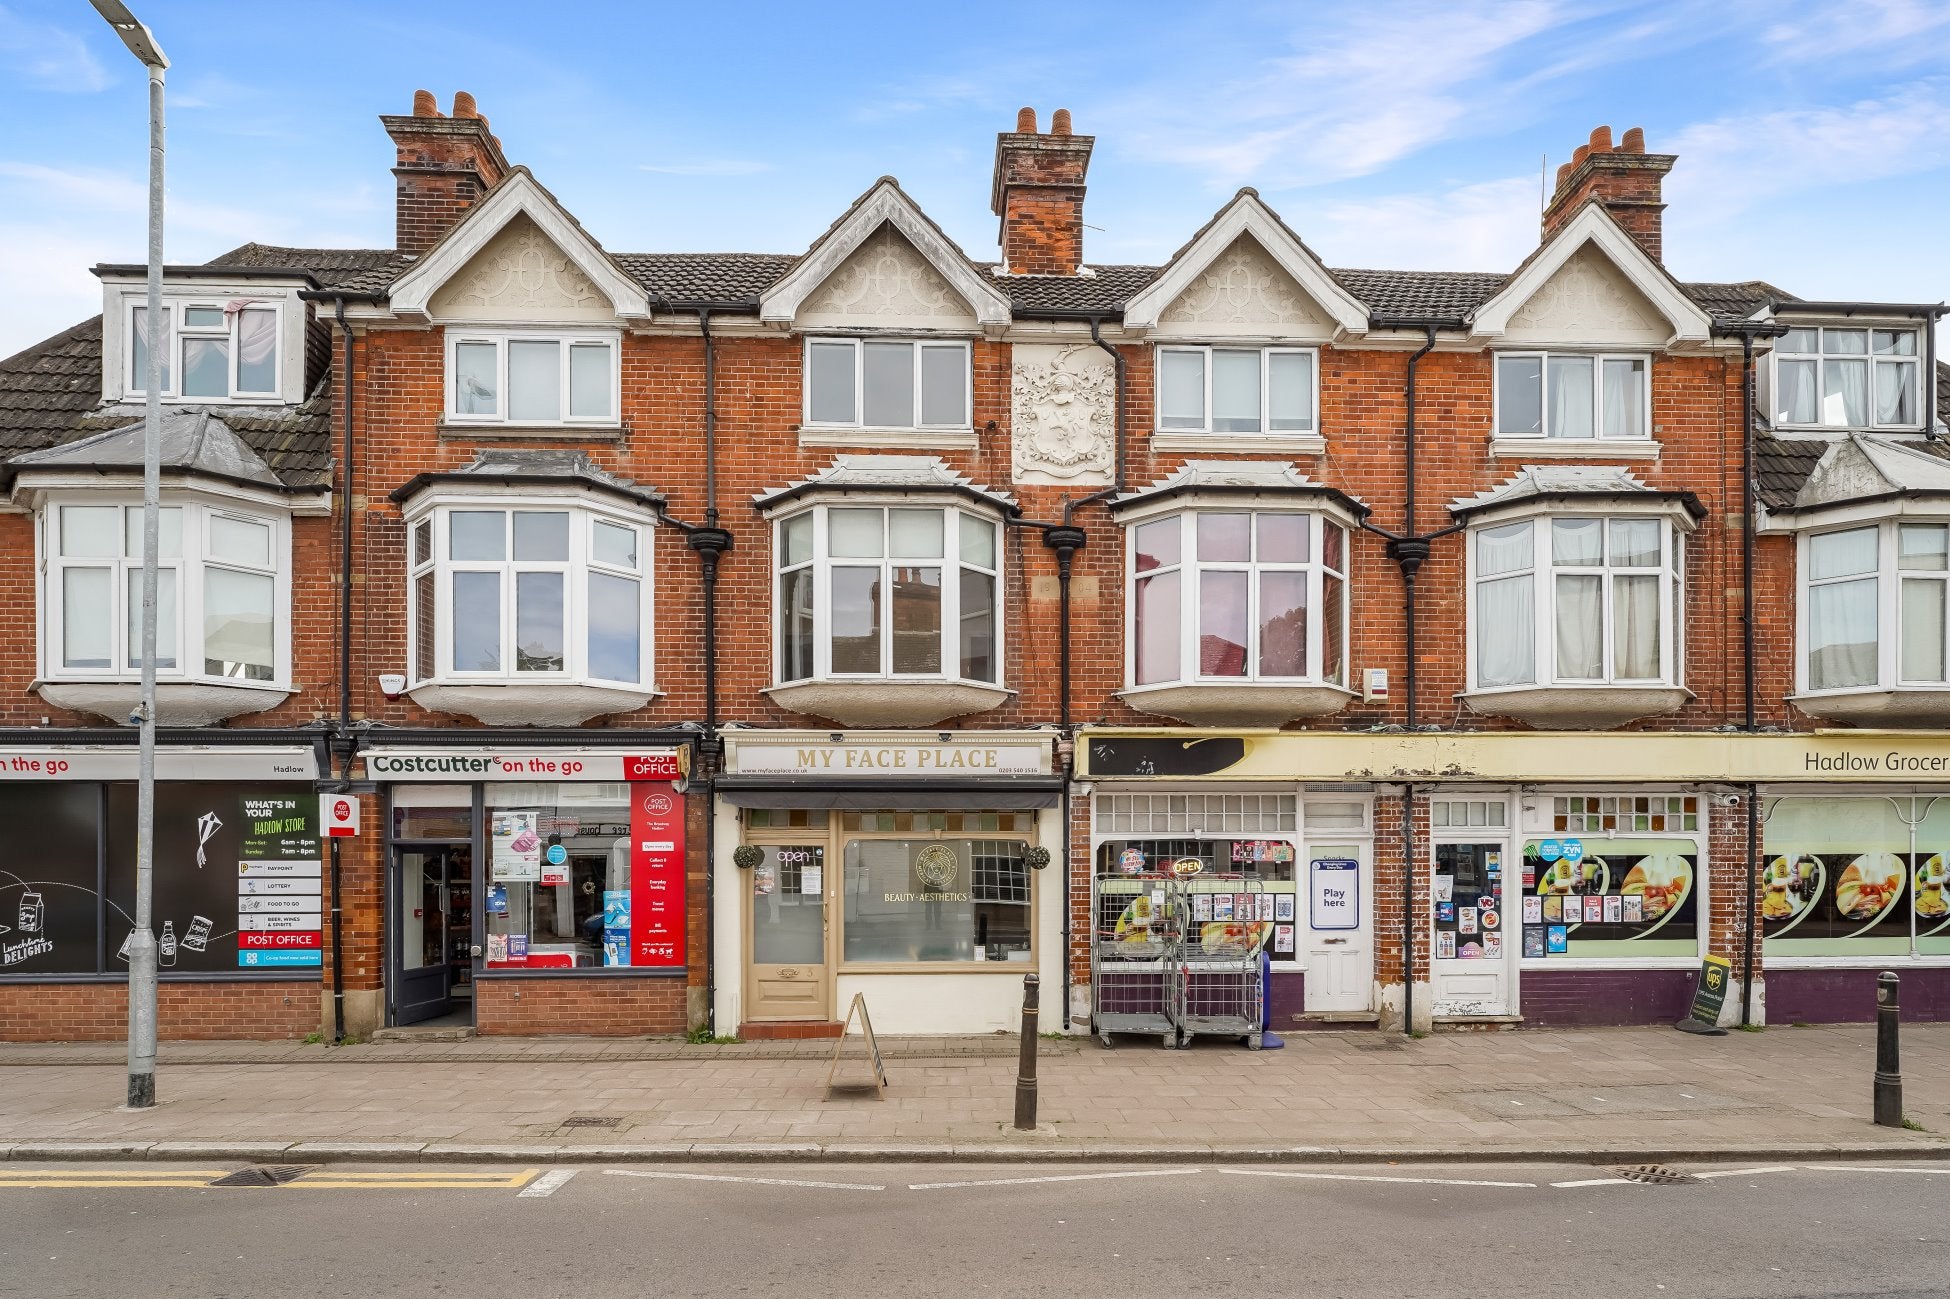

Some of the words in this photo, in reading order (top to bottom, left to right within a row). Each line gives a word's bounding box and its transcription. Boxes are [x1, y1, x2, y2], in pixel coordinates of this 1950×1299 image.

[797, 750, 834, 767] MY
[845, 750, 906, 767] FACE
[918, 750, 997, 767] PLACE
[1805, 751, 1879, 770] Hadlow
[1885, 751, 1950, 770] Grocer
[11, 757, 40, 771] the
[46, 761, 68, 775] go
[273, 765, 304, 773] Hadlow
[373, 756, 491, 772] Costcutter
[502, 761, 524, 772] on
[529, 758, 556, 772] the
[561, 761, 583, 775] go
[633, 763, 677, 774] OFFICE
[245, 800, 283, 809] WHAT'S
[285, 800, 296, 809] IN
[245, 809, 273, 818] YOUR
[254, 819, 283, 836] HADLOW
[284, 817, 306, 833] STORE
[1563, 846, 1581, 854] ZYN
[777, 851, 810, 867] open
[1174, 861, 1201, 872] OPEN
[884, 893, 915, 902] BEAUTY
[920, 892, 967, 902] AESTHETICS
[1323, 888, 1345, 899] Play
[1323, 899, 1346, 907] here
[3, 937, 45, 954] Lunchtime
[247, 935, 274, 945] POST
[276, 935, 312, 945] OFFICE
[4, 940, 53, 965] DELIGHTS
[1708, 972, 1720, 987] ups
